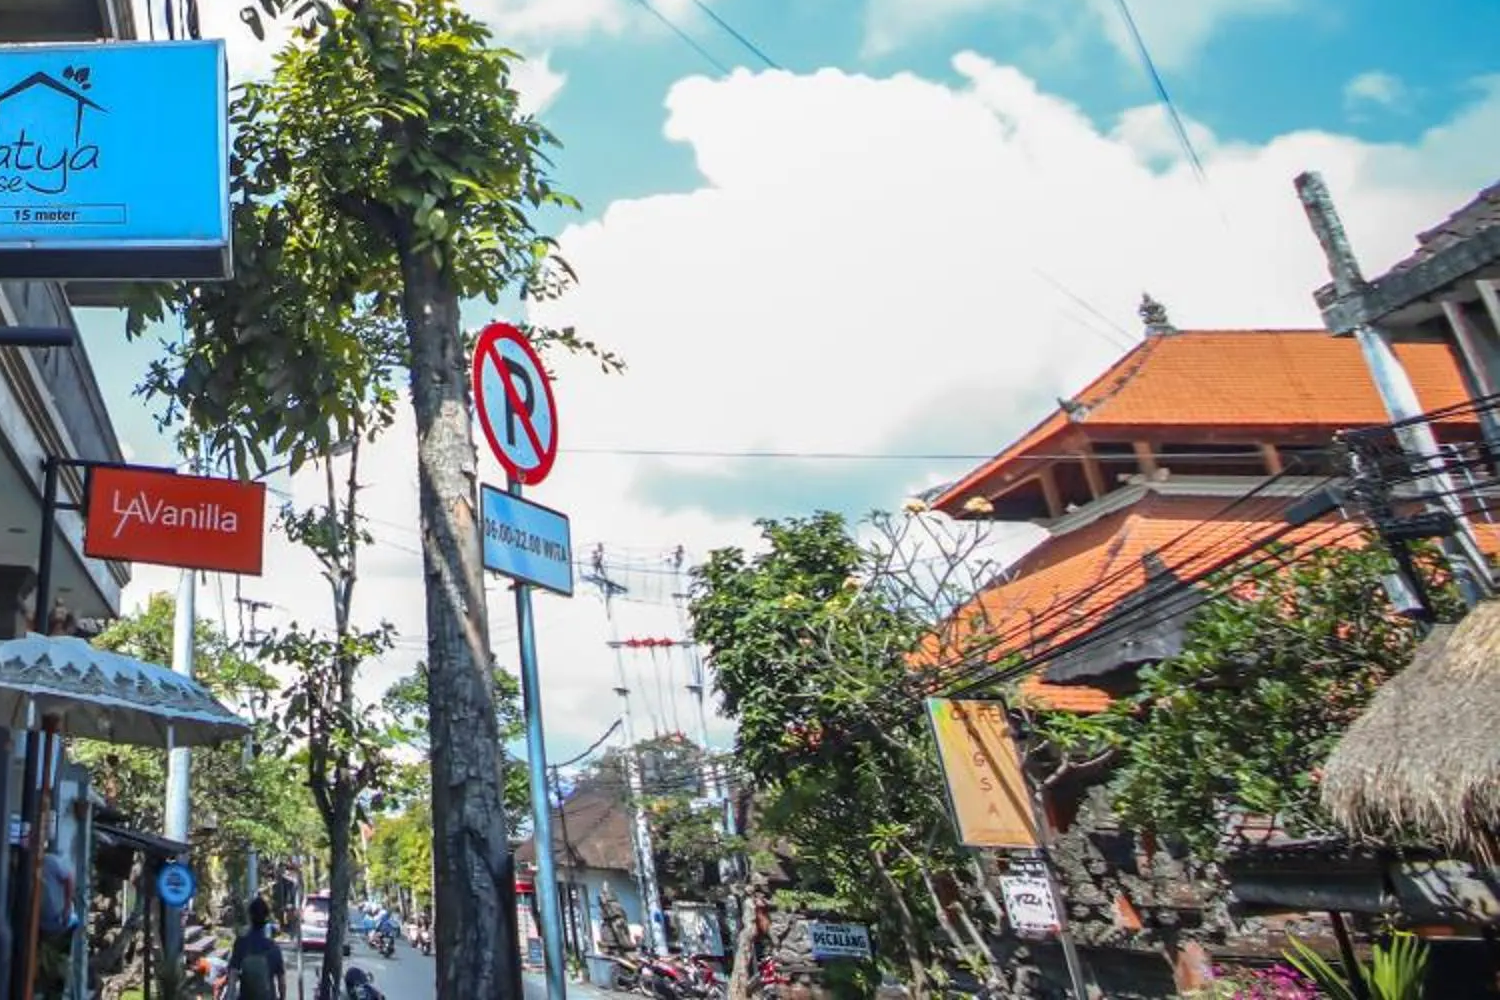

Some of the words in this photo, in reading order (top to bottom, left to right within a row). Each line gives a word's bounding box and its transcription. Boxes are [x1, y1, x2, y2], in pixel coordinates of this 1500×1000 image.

[14, 209, 32, 222] 15
[34, 209, 78, 223] meter
[812, 931, 867, 948] PECALANG
